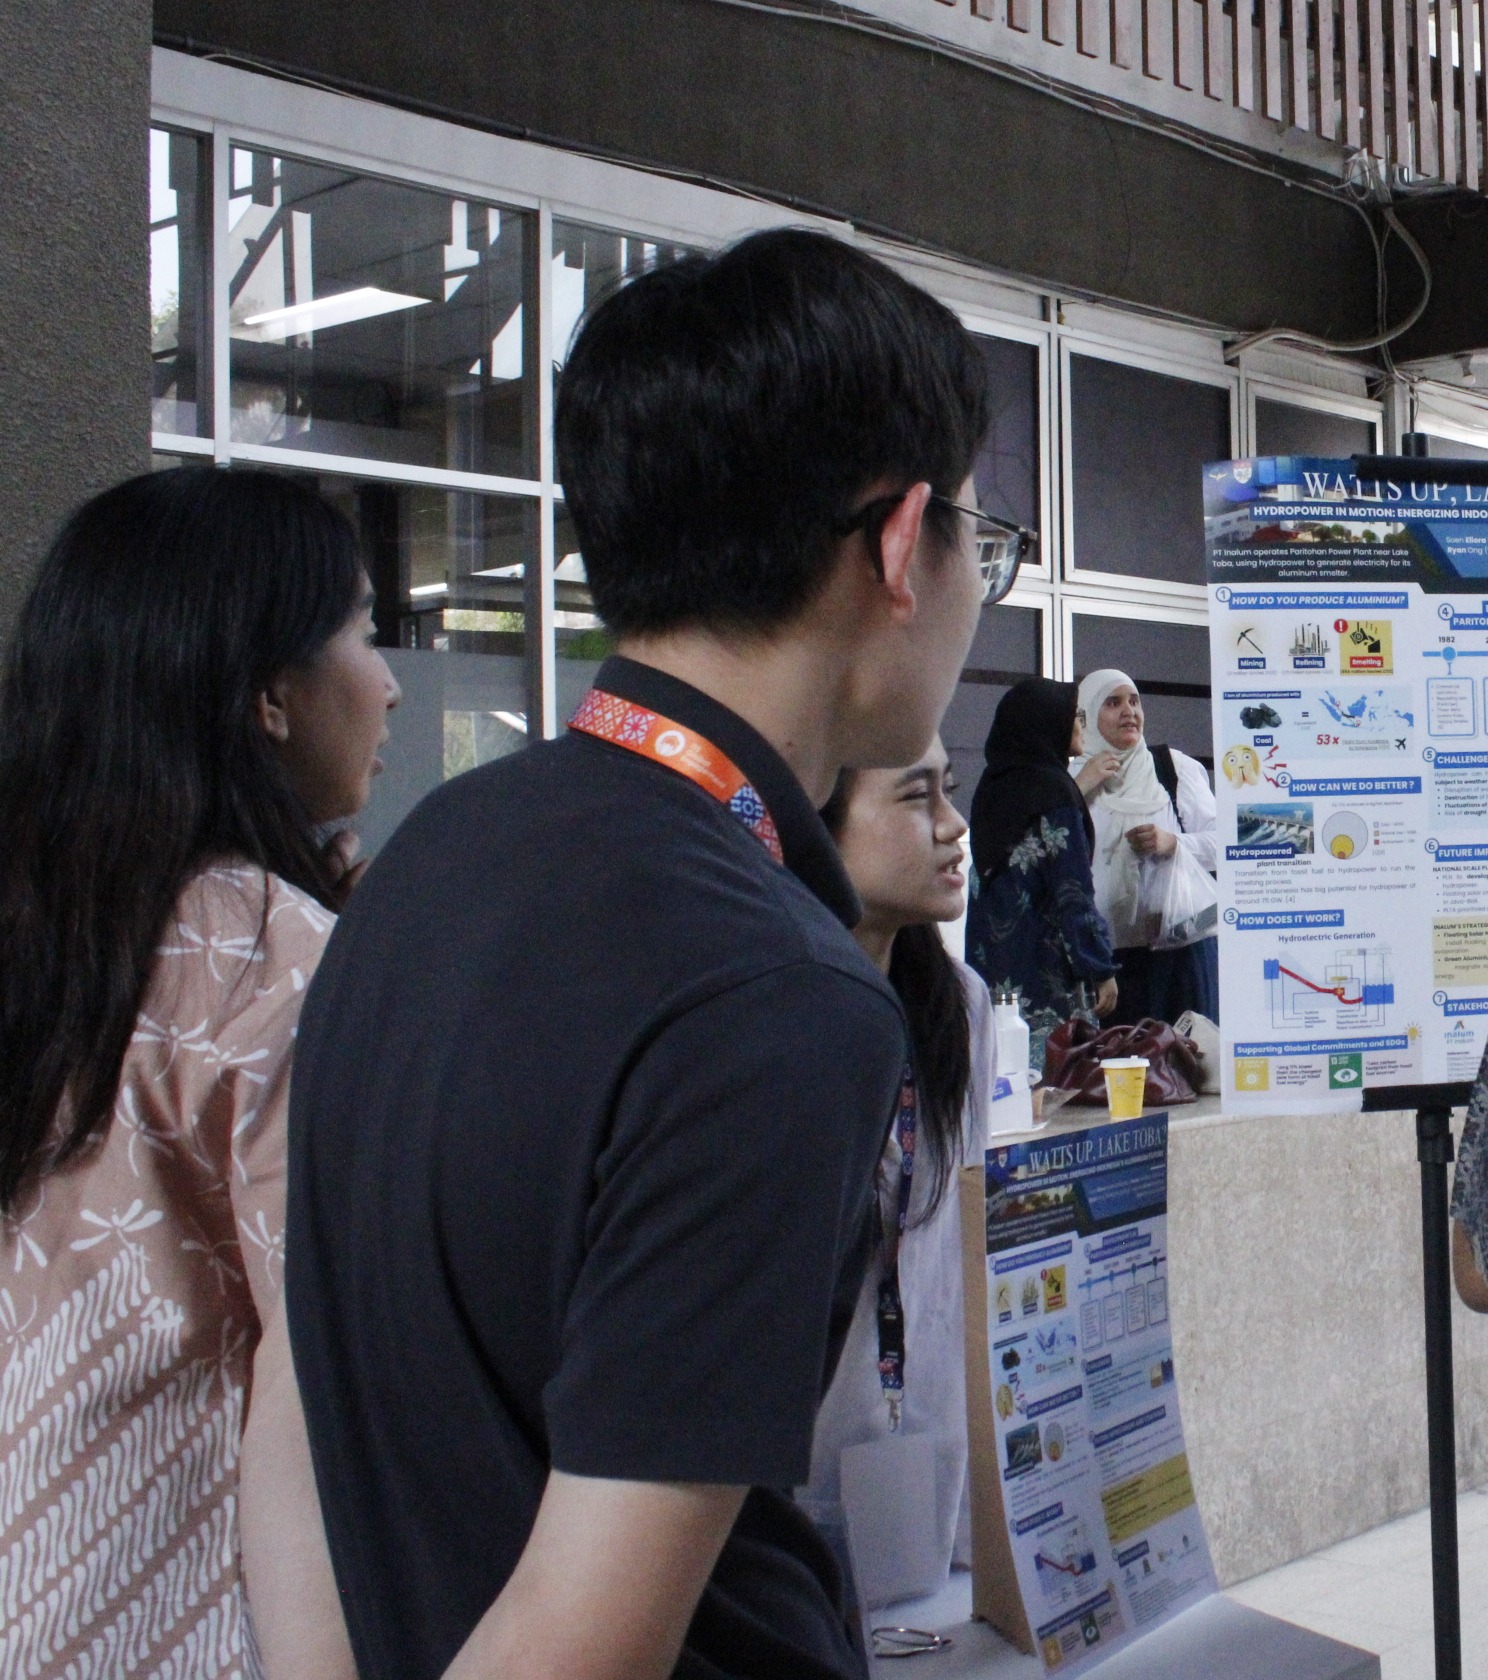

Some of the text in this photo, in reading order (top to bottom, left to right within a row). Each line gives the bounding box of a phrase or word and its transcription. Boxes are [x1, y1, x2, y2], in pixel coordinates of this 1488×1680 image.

[1253, 506, 1334, 517] HYDROPOWER
[1335, 507, 1347, 516] IN
[1349, 507, 1396, 518] MOTION:
[1397, 508, 1460, 519] ENERGIZING
[1466, 536, 1486, 544] Eliora
[1254, 549, 1288, 557] operates
[1448, 546, 1466, 555] Ryan
[1236, 560, 1257, 569] using
[1259, 559, 1305, 569] hydropower
[1317, 561, 1351, 569] generate
[1353, 559, 1388, 569] electricity
[1232, 597, 1257, 605] HOW
[1299, 596, 1344, 604] PRODUCE
[1346, 596, 1405, 604] ALUMINIUM?
[1442, 607, 1449, 617] 4
[1240, 660, 1264, 668] Mining
[1295, 659, 1323, 667] Refining
[1352, 659, 1382, 667] Smelting
[1317, 734, 1330, 745] 53
[1427, 751, 1433, 759] 5
[1434, 771, 1468, 779] Hydropower
[1280, 776, 1287, 785] 2
[1293, 784, 1317, 792] HOW
[1319, 783, 1339, 792] CAN
[1342, 783, 1357, 791] WE
[1359, 782, 1373, 790] DO
[1375, 782, 1406, 790] BETTER
[1428, 842, 1435, 850] 6
[1229, 847, 1292, 857] Hydropowered
[1439, 849, 1472, 857] FUTURE
[1257, 859, 1311, 868] plant transition
[1338, 866, 1376, 875] hydropower
[1235, 879, 1264, 887] smelting
[1315, 886, 1325, 894] big
[1328, 885, 1356, 894] potential
[1370, 883, 1407, 893] hydropower
[1235, 897, 1260, 905] around
[1228, 911, 1234, 921] 3
[1240, 913, 1340, 925] HOW DOES IT WORK?
[1278, 932, 1376, 943] Hydroelectric Generation
[1237, 1039, 1406, 1055] Supporting Global Commitments and SDGs
[1029, 1143, 1073, 1173] WATTS
[1099, 1131, 1129, 1157] LAKE
